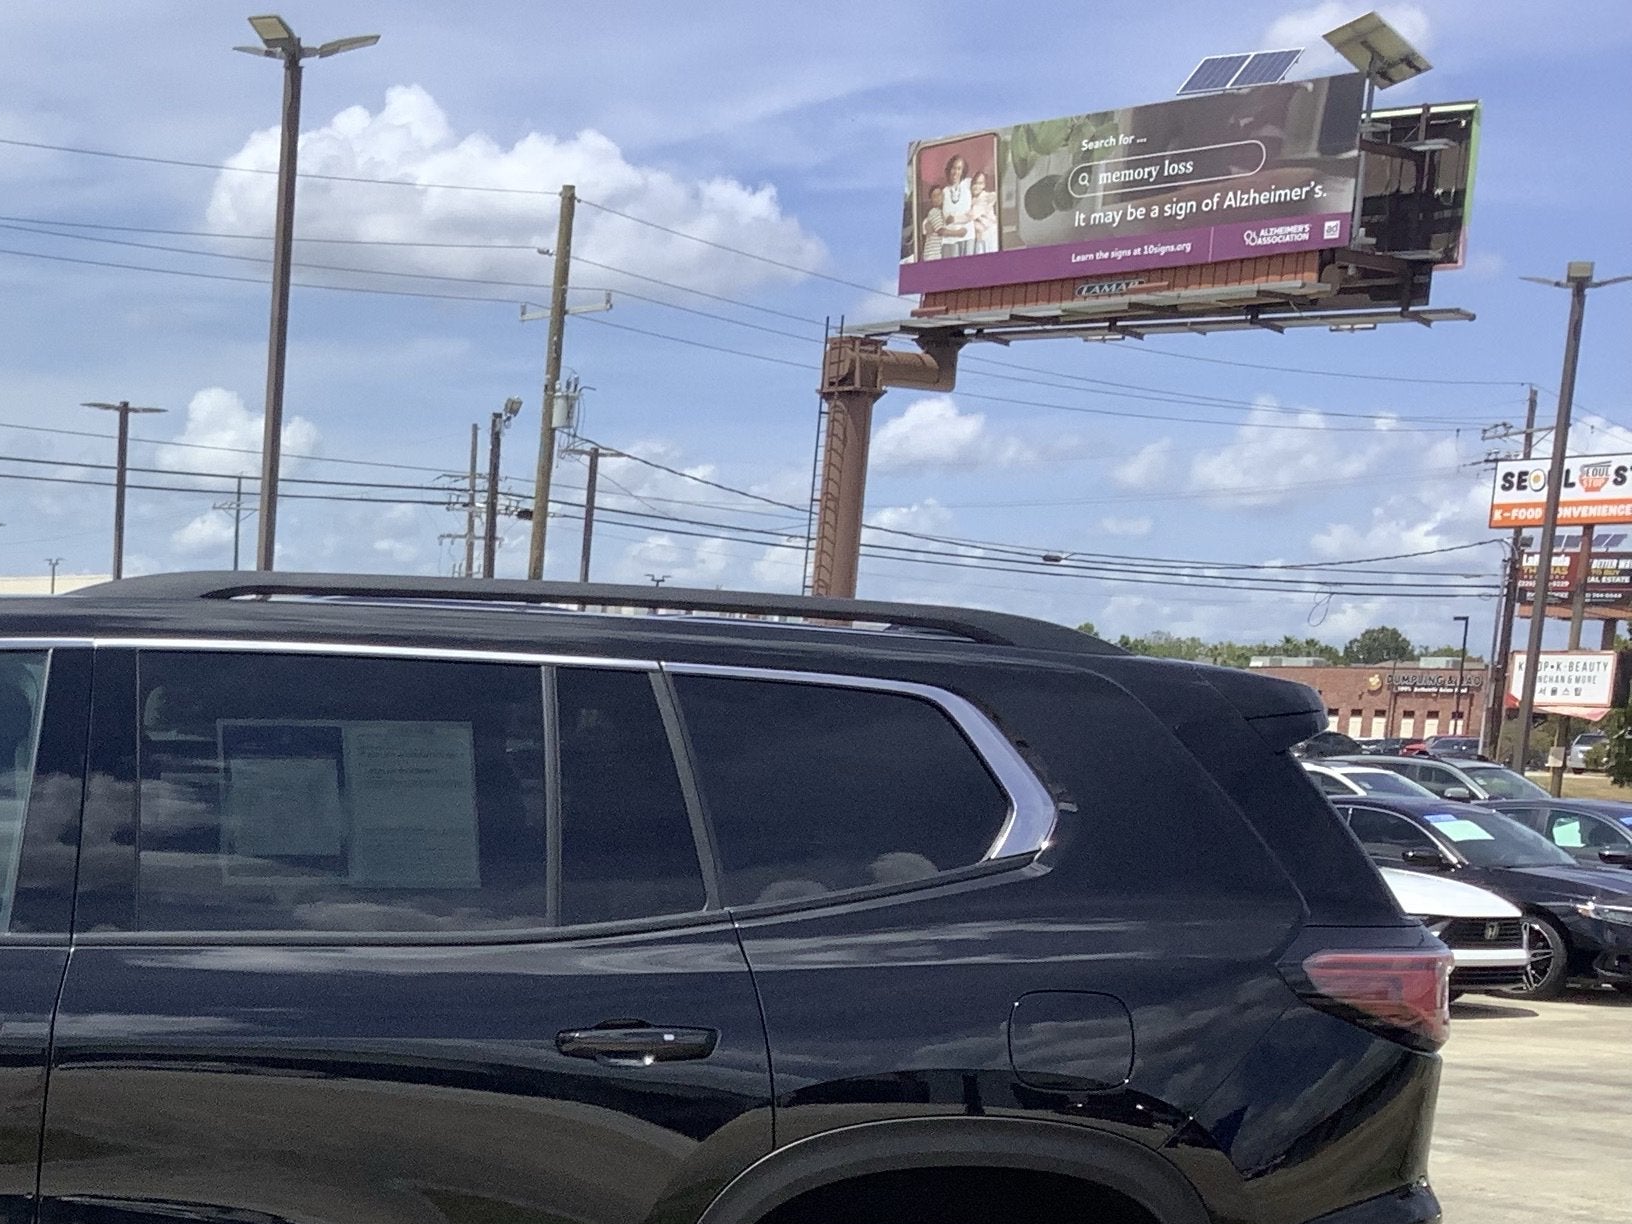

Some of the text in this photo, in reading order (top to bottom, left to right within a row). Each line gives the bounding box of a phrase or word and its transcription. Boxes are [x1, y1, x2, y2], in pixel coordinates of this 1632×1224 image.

[1081, 136, 1116, 151] Search
[1118, 134, 1135, 145] for
[1098, 159, 1194, 185] memory loss
[1074, 211, 1086, 227] It
[1090, 209, 1123, 227] may
[1126, 204, 1146, 220] be
[1150, 205, 1159, 218] a
[1164, 197, 1197, 220] sign
[1201, 193, 1221, 211] of
[1256, 233, 1310, 245] ASSOCIATION
[1071, 242, 1192, 262] Learn the signs at 10signs.org
[1500, 468, 1576, 492] SEOL
[1557, 503, 1632, 519] ONVENIENCE
[1601, 575, 1630, 583] ESTATE
[1386, 674, 1443, 686] DUMPLING
[1574, 675, 1597, 684] MORE
